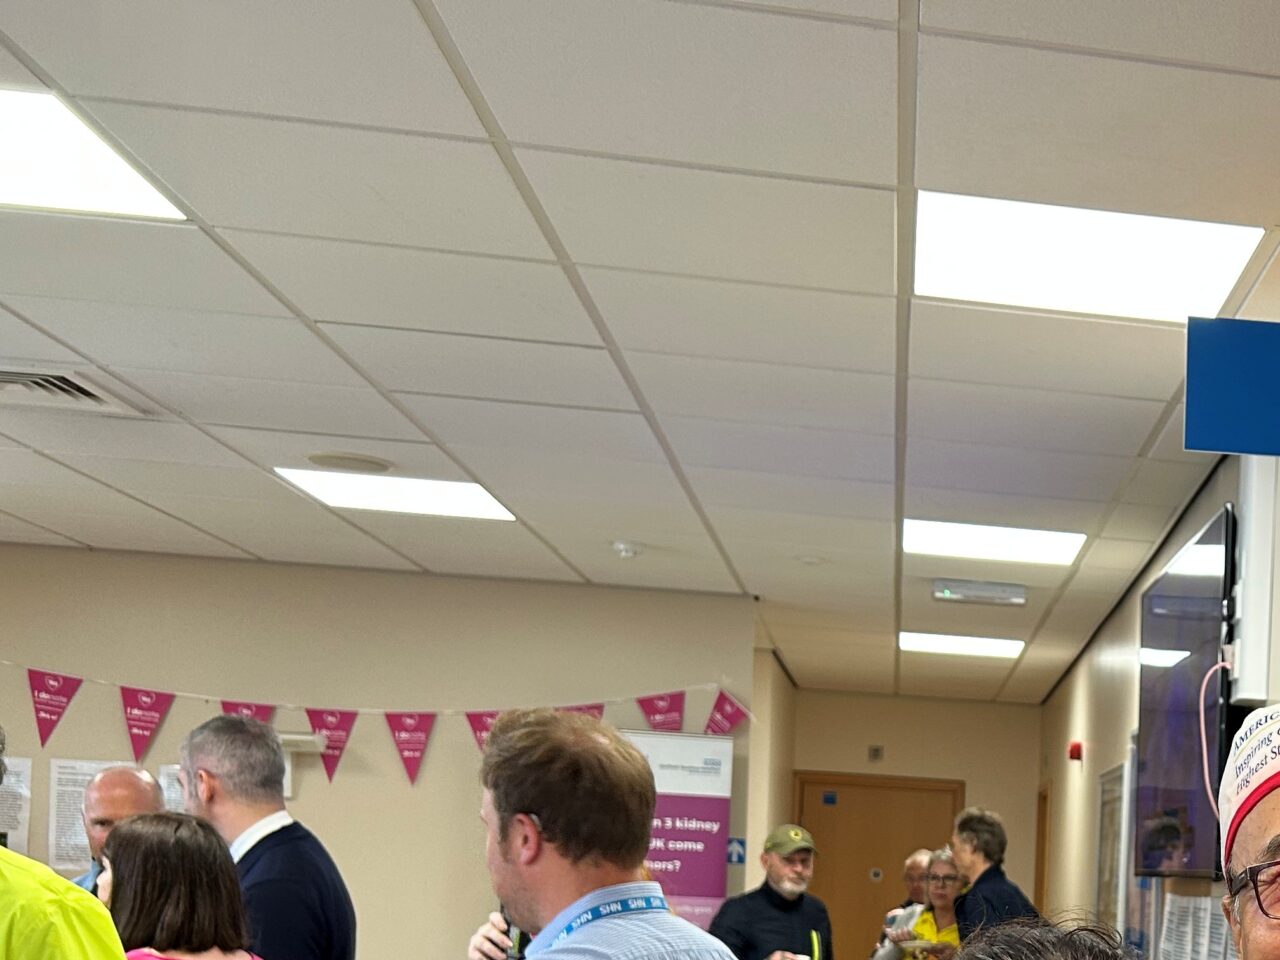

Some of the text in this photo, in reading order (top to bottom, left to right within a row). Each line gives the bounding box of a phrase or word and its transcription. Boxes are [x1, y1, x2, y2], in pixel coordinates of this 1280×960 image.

[1235, 732, 1273, 779] Inspiring
[1236, 755, 1269, 796] Highest
[664, 816, 673, 830] 3
[675, 816, 721, 834] kidney
[668, 840, 705, 852] come
[599, 901, 623, 916] NHS
[628, 898, 646, 909] NHS
[571, 911, 592, 930] NHS
